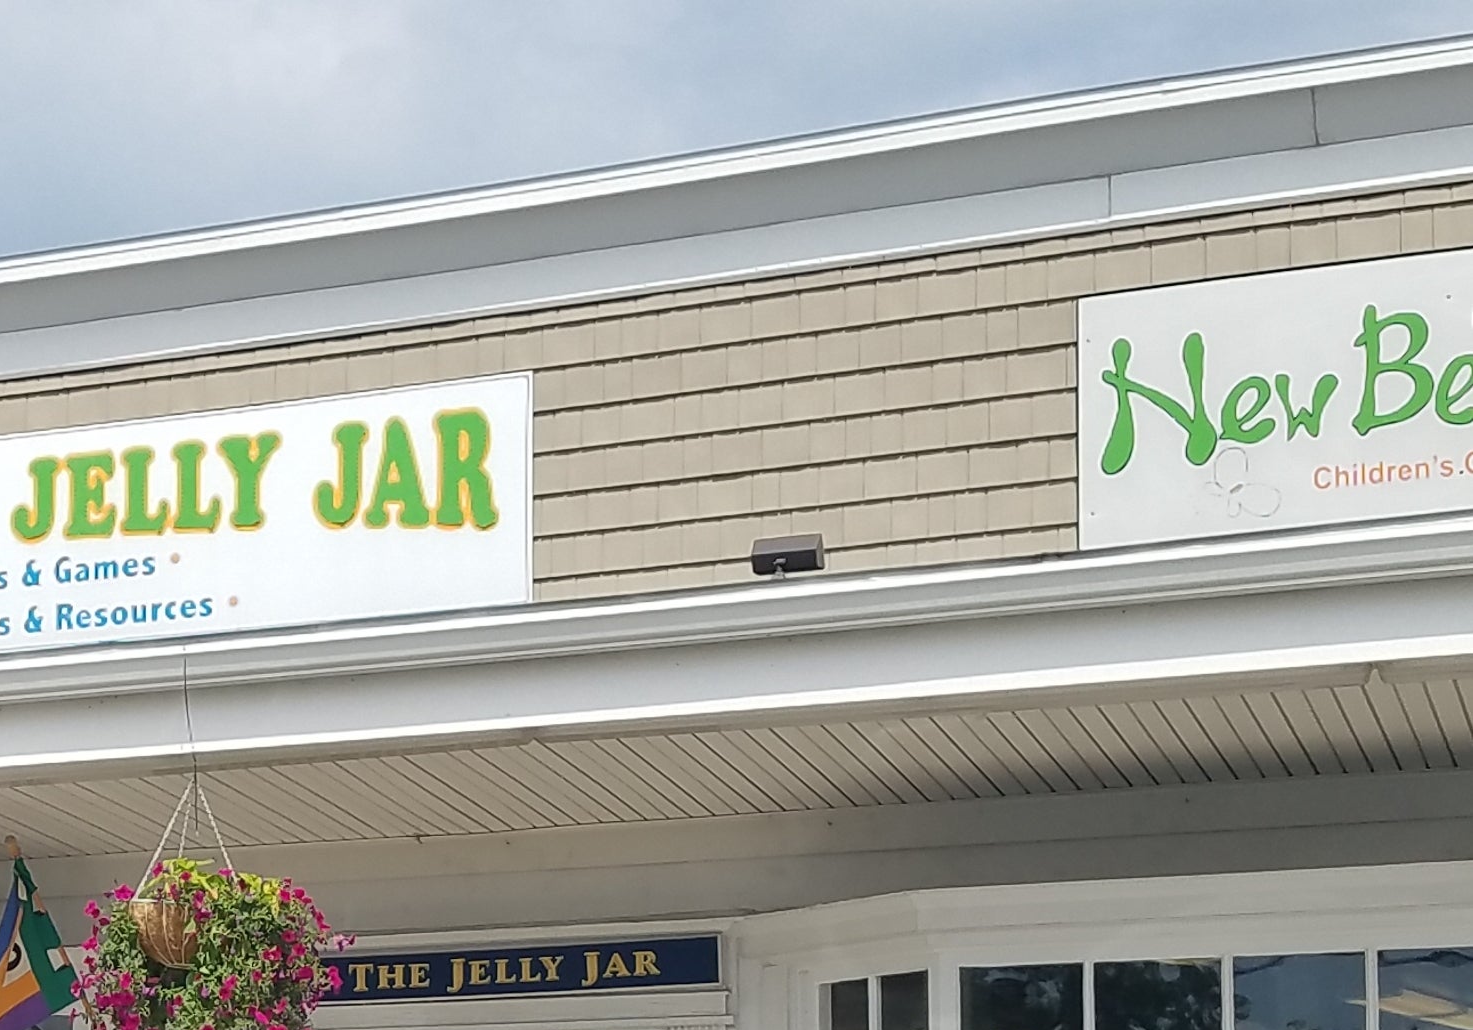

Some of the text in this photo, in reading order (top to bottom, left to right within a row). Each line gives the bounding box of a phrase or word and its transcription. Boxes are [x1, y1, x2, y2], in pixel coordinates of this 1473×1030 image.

[1101, 332, 1338, 475] New
[10, 430, 283, 545] JELLY
[312, 406, 500, 532] JAR
[1314, 453, 1454, 491] Children's
[22, 559, 42, 587] &
[54, 556, 156, 584] Games
[24, 605, 44, 634] &
[56, 597, 213, 630] Resources
[349, 963, 430, 993] THE
[447, 956, 564, 993] JELLY
[582, 950, 661, 987] JAR
